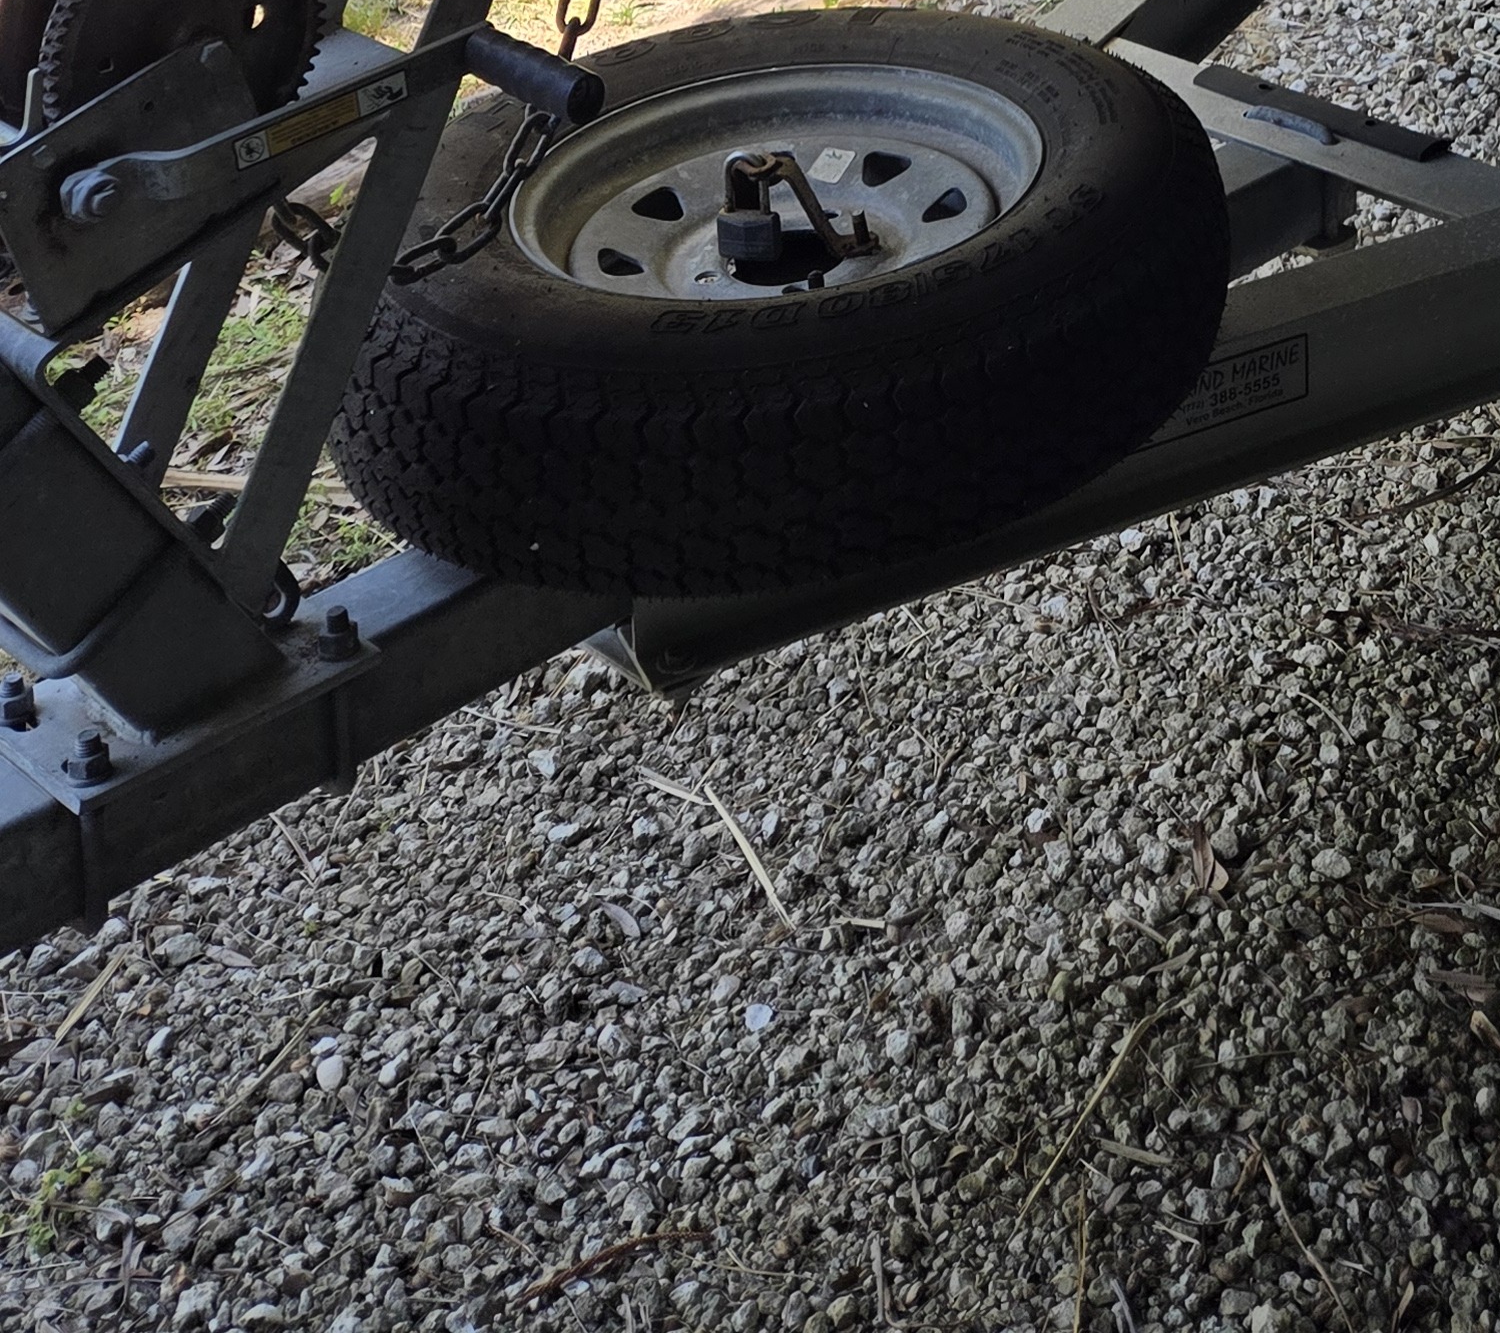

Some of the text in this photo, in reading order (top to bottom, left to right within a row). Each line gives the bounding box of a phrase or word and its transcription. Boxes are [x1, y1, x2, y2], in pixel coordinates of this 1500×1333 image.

[1231, 343, 1301, 382] MARINE
[1186, 414, 1210, 427] Vero
[1248, 389, 1284, 406] Florida
[1209, 373, 1281, 407] 388-5555
